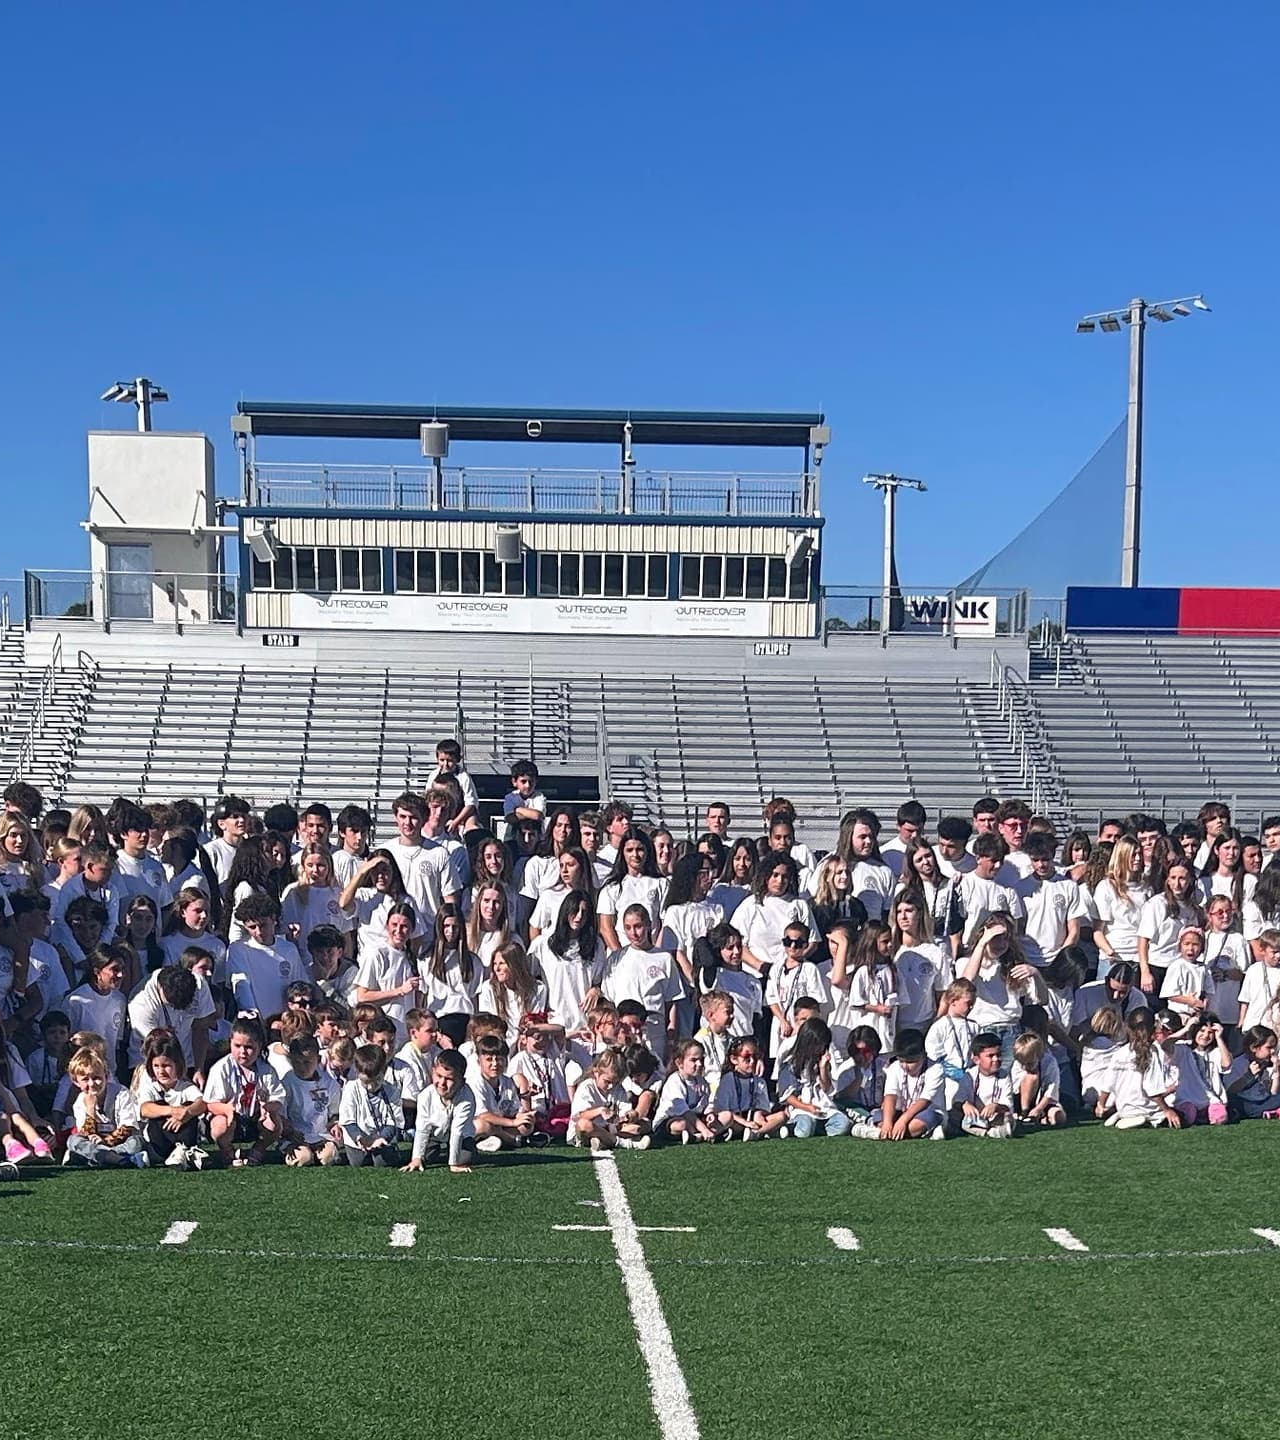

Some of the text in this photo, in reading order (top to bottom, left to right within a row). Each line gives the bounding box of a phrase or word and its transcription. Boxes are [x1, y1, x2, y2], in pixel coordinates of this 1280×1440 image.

[316, 600, 389, 609] OUTRECOVER
[435, 602, 509, 612] OUTRECOVER
[555, 604, 628, 614] OUTRECOVER
[911, 600, 990, 619] WINK
[674, 606, 747, 616] OUTRECOVER
[755, 643, 789, 655] STRIPES
